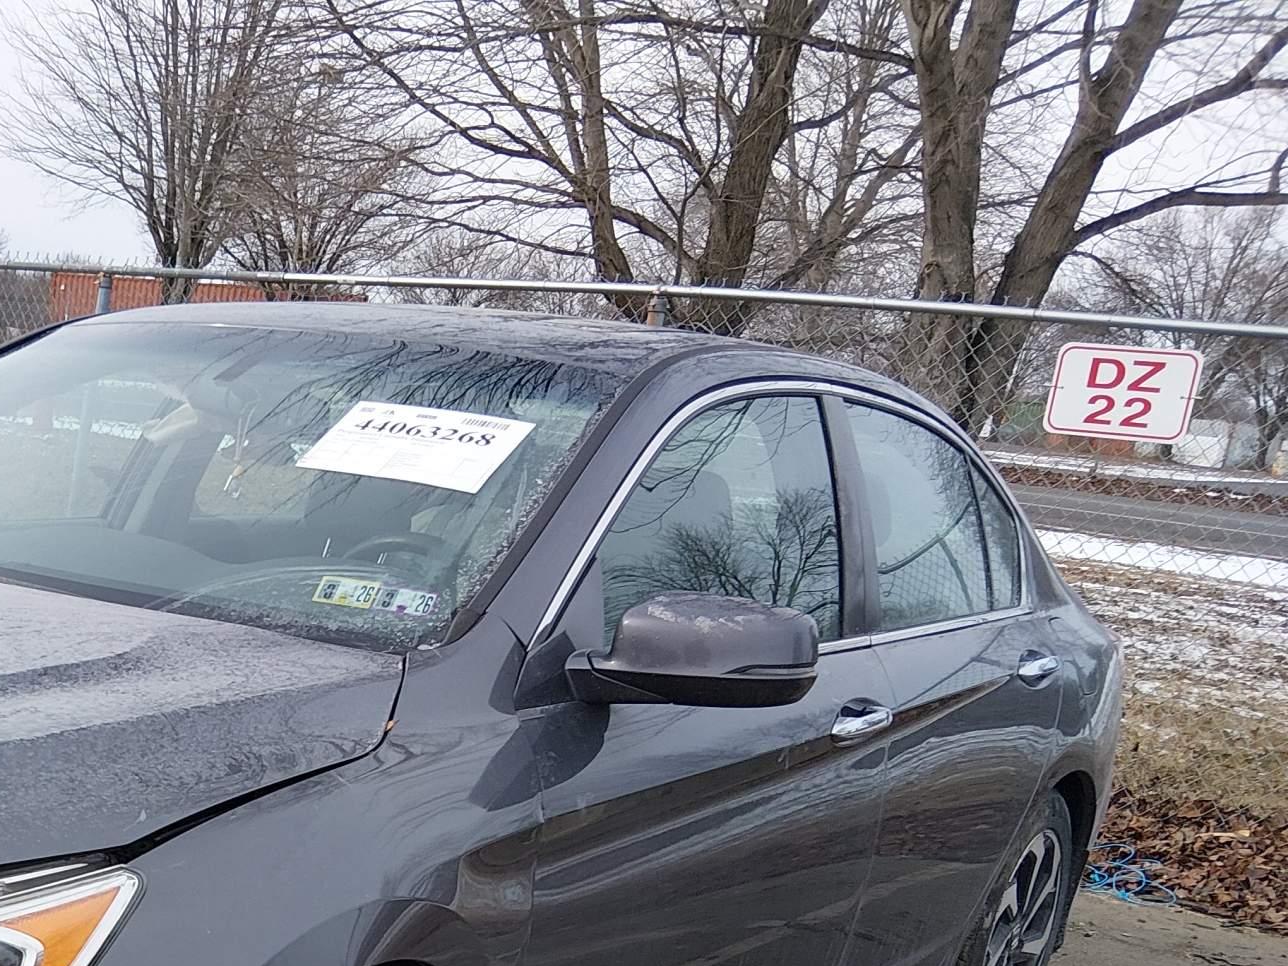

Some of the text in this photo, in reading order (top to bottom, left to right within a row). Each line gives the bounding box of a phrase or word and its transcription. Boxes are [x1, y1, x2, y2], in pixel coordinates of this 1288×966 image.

[1086, 357, 1168, 393] DZ
[1083, 395, 1152, 429] 22
[355, 418, 497, 446] 44063268
[355, 585, 375, 603] 26
[415, 595, 434, 614] 26
